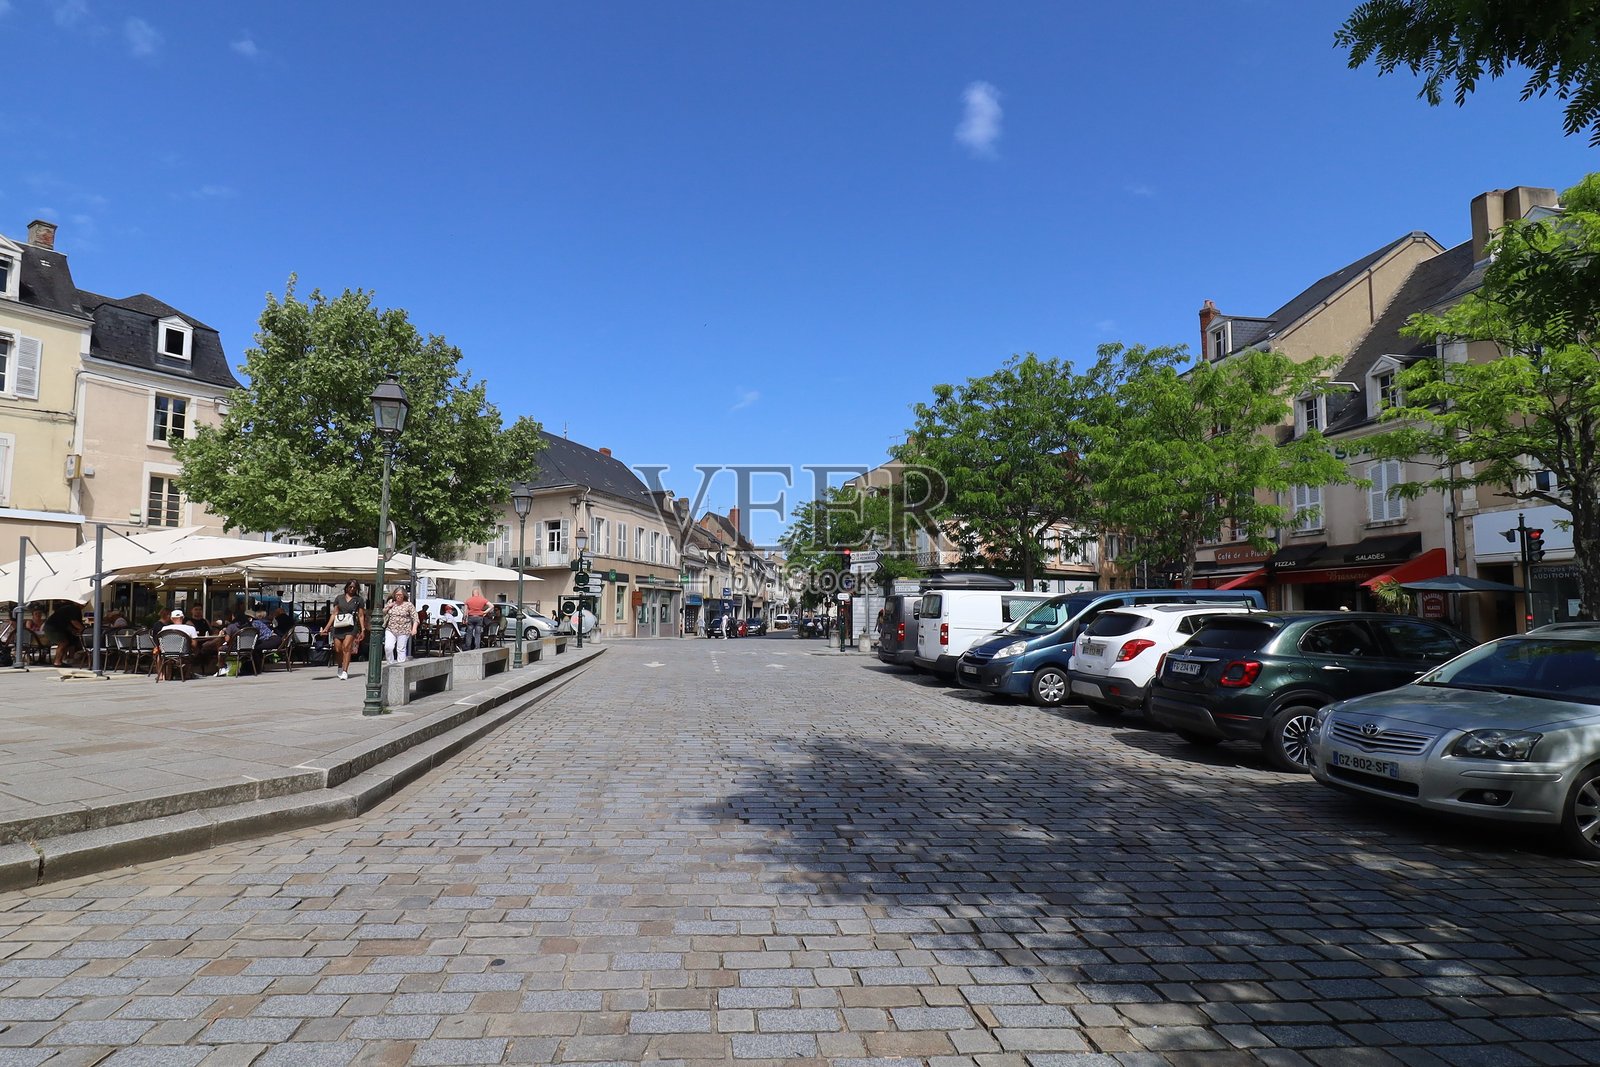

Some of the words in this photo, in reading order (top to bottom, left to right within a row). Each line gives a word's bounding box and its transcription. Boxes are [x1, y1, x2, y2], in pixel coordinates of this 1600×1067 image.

[1217, 551, 1231, 560] Café
[1355, 553, 1386, 561] SALADES
[1326, 571, 1369, 581] Brasserie
